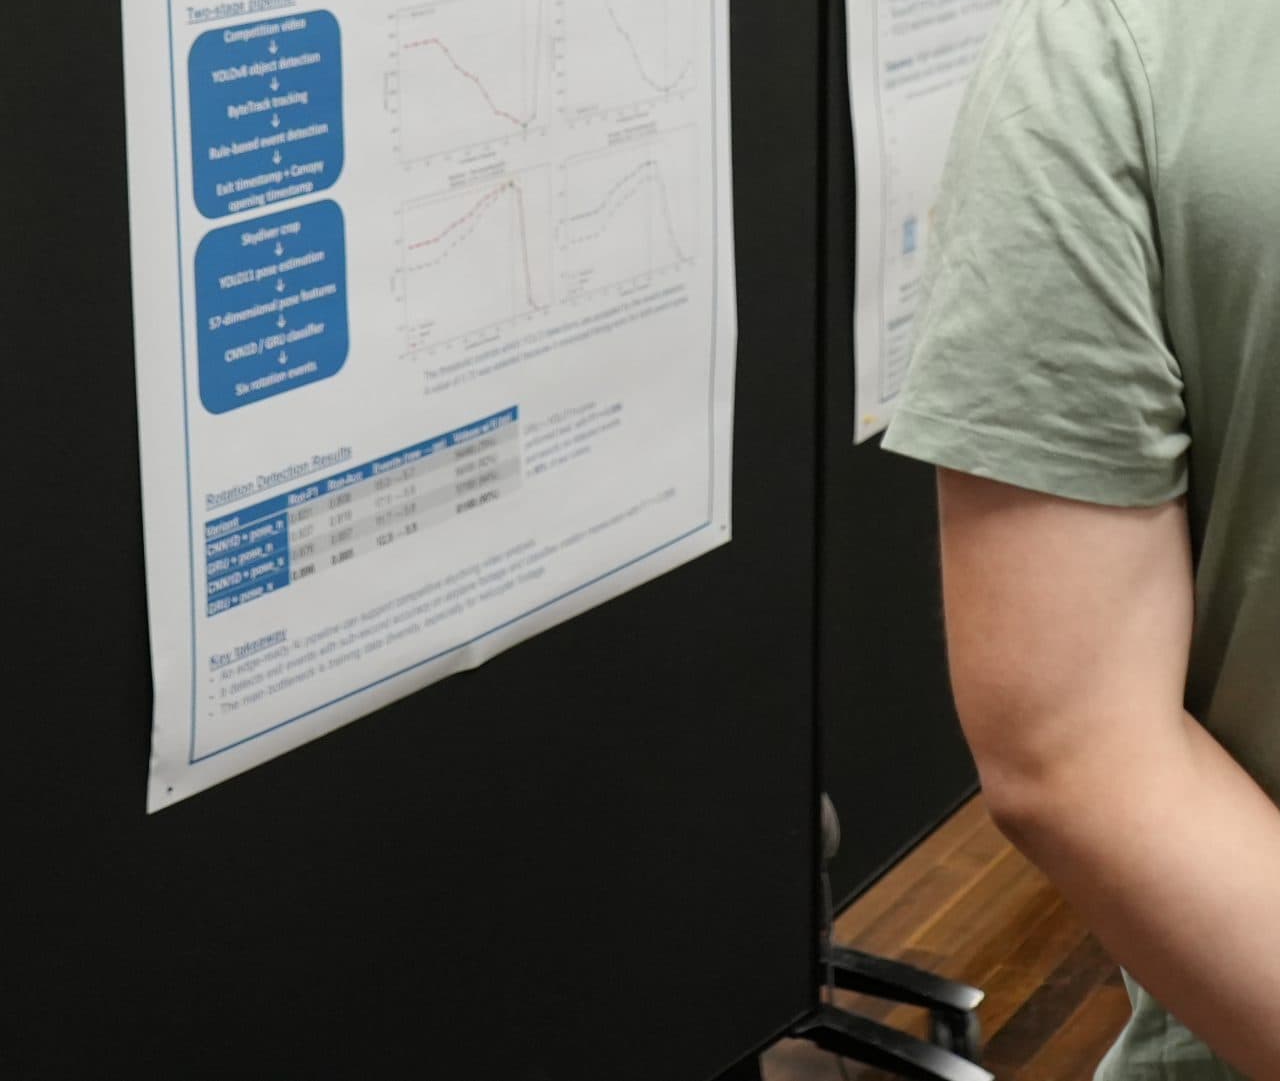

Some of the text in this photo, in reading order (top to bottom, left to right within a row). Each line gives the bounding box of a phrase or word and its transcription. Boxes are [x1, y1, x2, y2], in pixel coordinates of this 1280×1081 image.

[187, 1, 243, 22] Two-stage
[223, 18, 306, 42] Competition video
[249, 60, 277, 75] object
[279, 52, 320, 69] detection
[227, 91, 308, 118] ByteTrack tracking
[209, 123, 328, 159] Rule-based event detection
[216, 181, 234, 195] Exit
[235, 170, 283, 191] timestamp
[290, 161, 323, 177] Canopy
[241, 227, 279, 245] Skydiver
[206, 447, 352, 508] Rotation Detection Results
